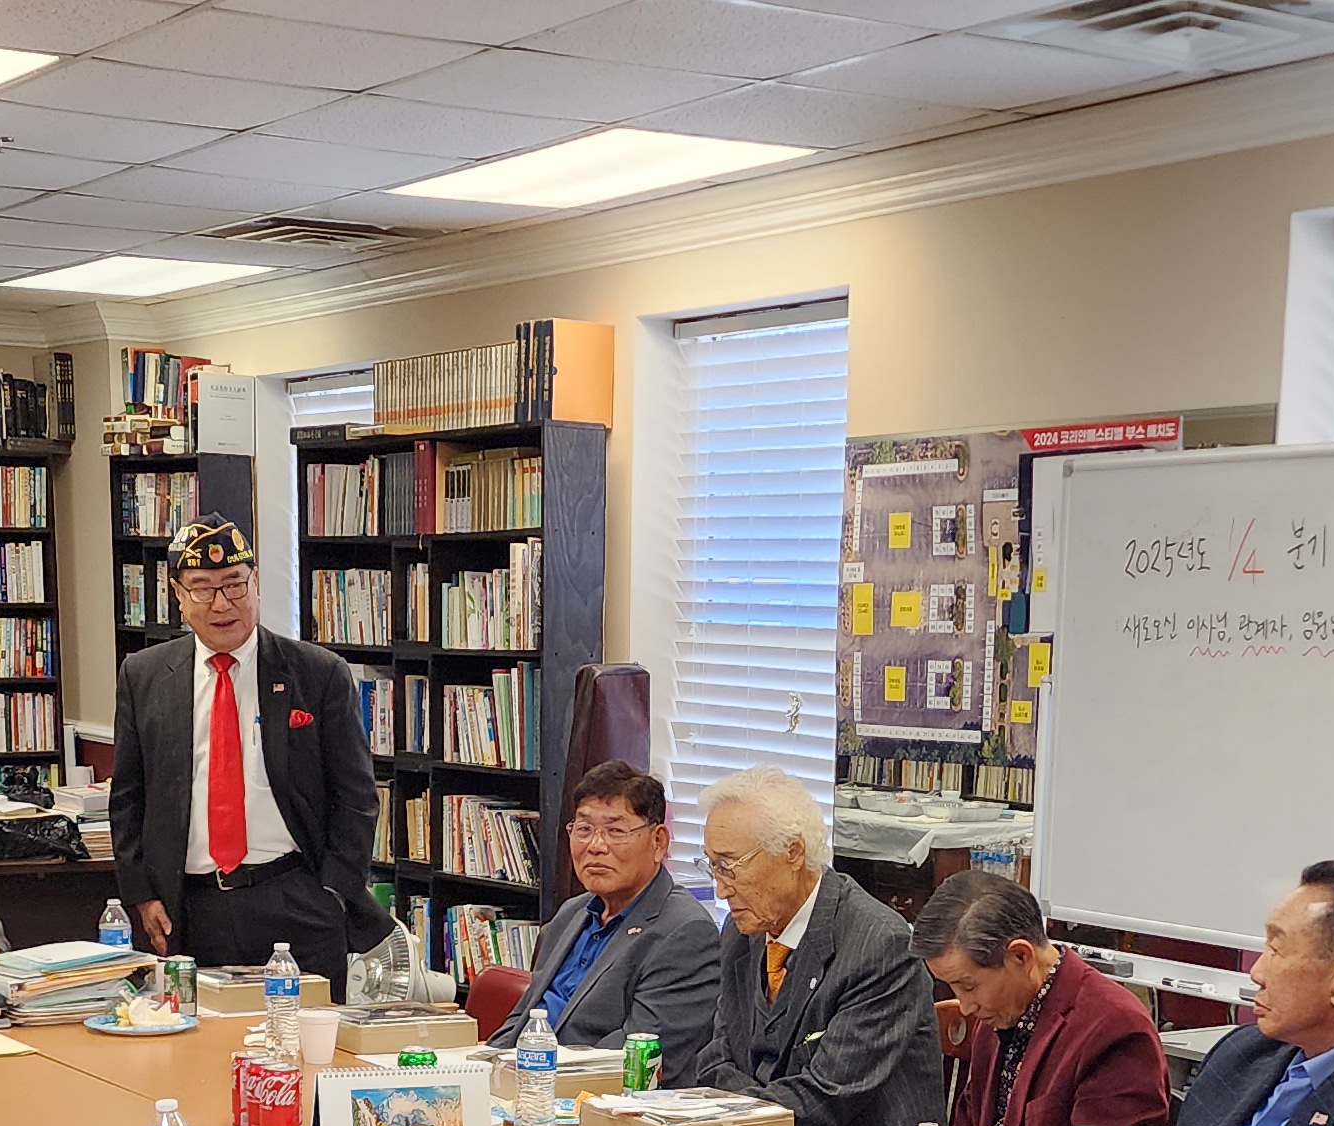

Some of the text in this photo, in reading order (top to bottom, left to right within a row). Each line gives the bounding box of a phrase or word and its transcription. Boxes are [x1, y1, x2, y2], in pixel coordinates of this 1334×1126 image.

[1033, 431, 1059, 447] 2024
[1124, 535, 1211, 579] 2025년도
[1286, 517, 1327, 571] 분기
[255, 1072, 299, 1106] Cola
